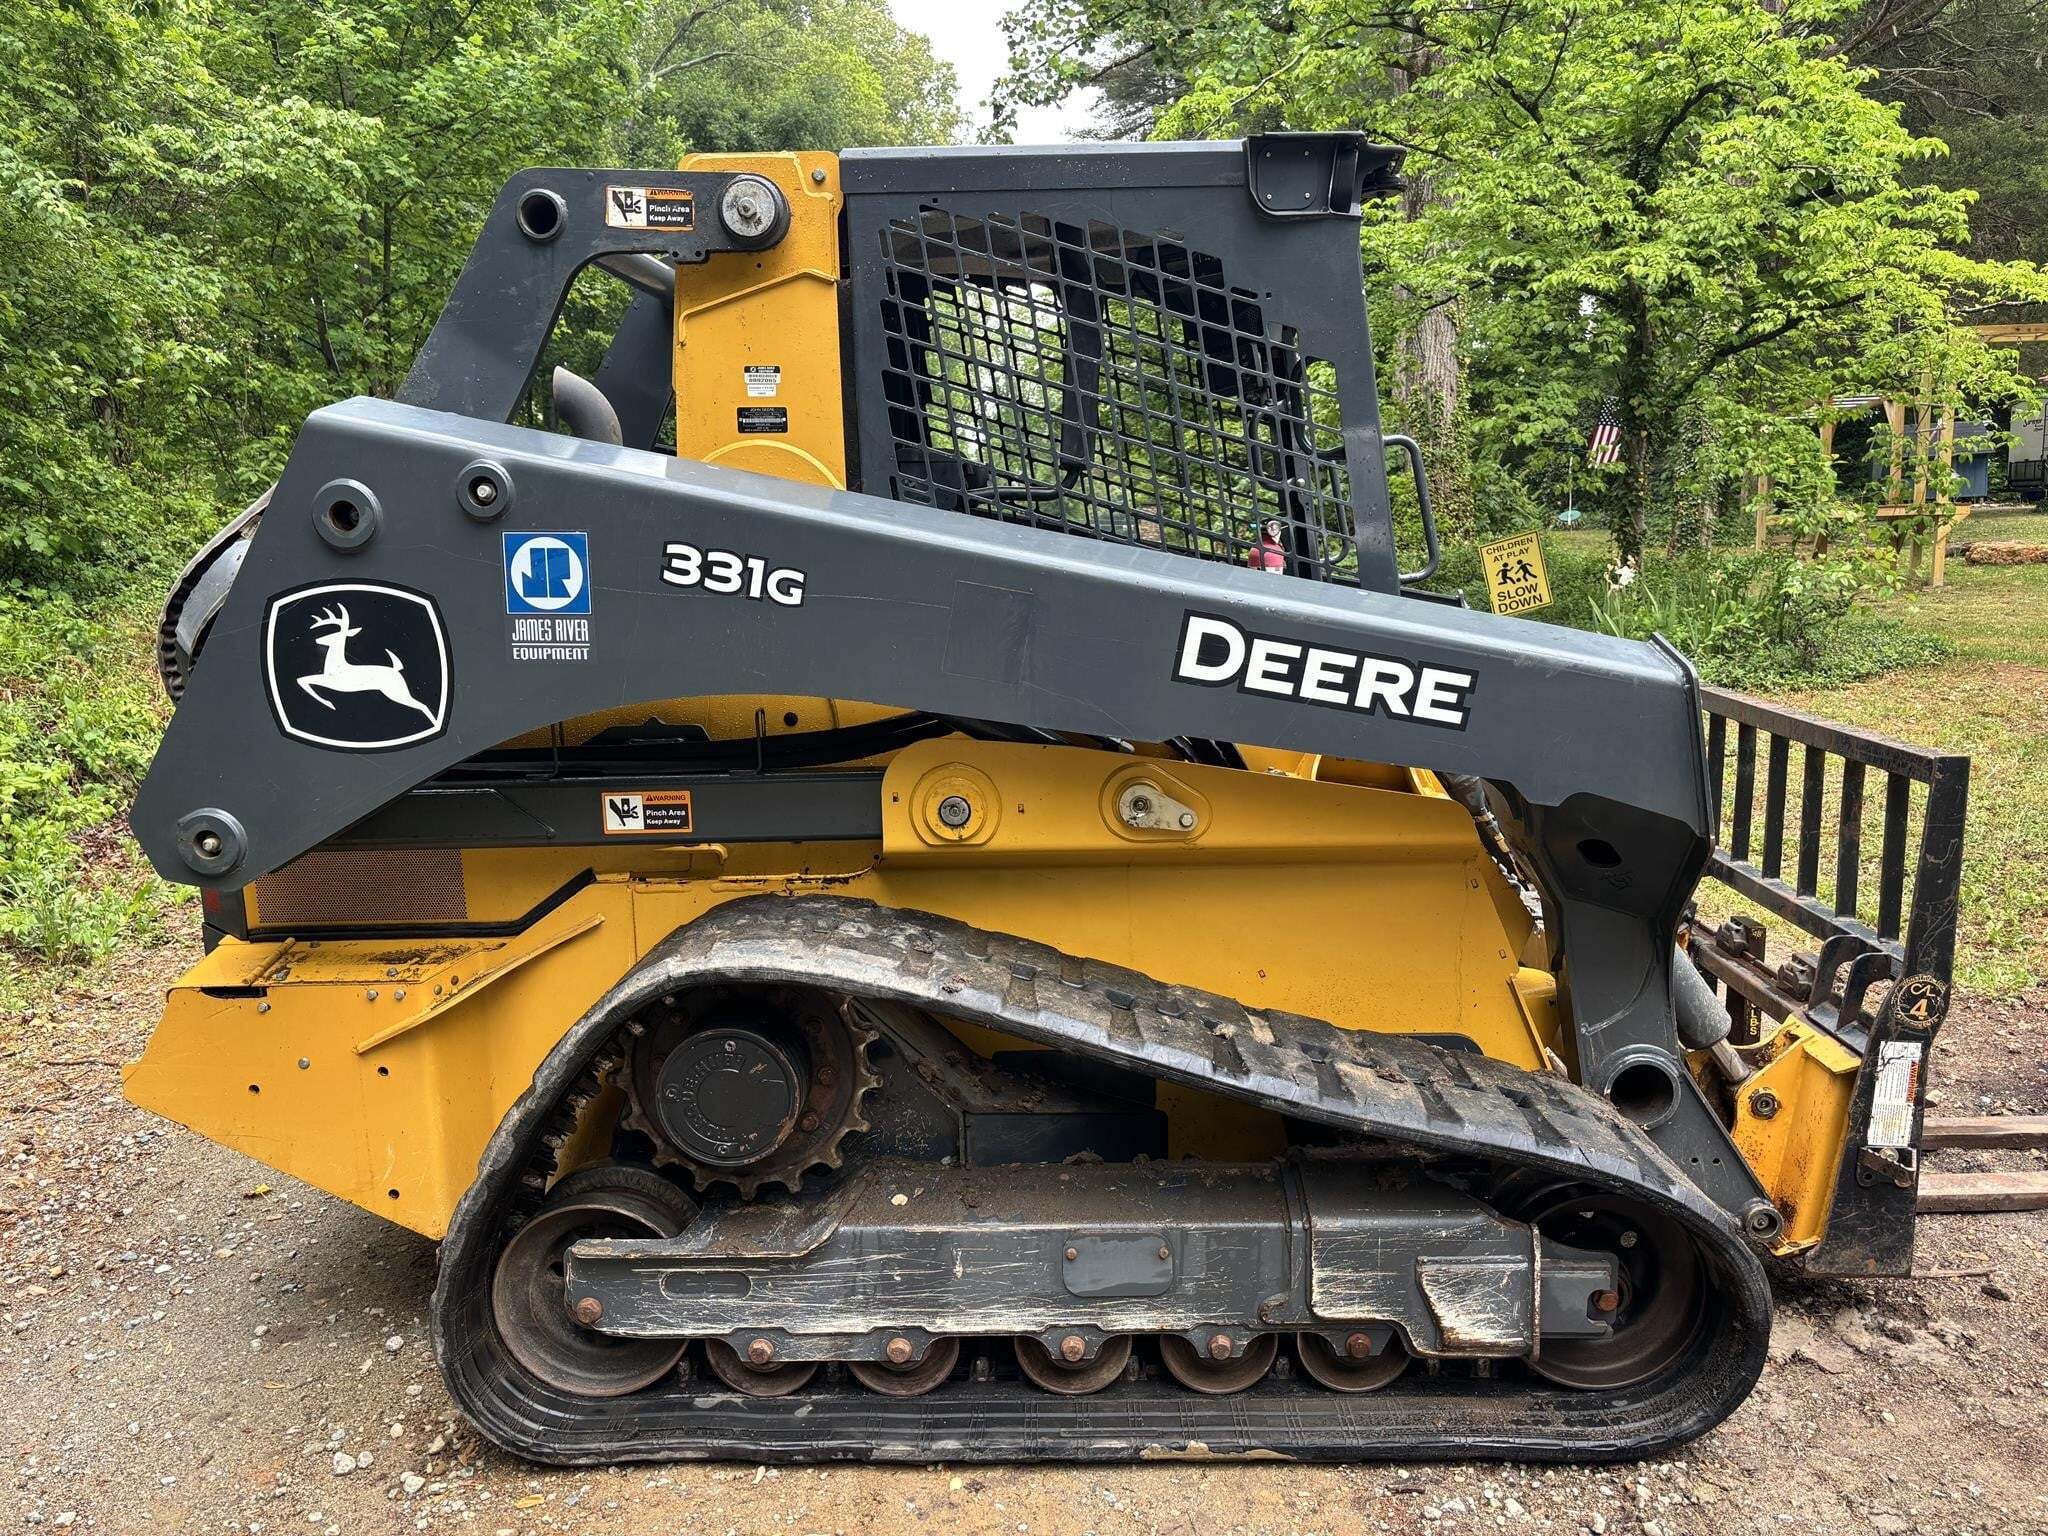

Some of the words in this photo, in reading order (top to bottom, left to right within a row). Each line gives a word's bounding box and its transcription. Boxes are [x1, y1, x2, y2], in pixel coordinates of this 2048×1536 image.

[649, 204, 671, 213] Pinch
[672, 205, 690, 213] Area
[649, 214, 666, 222] Keep
[667, 215, 685, 223] Away
[1486, 536, 1534, 555] CHILDREN
[1493, 554, 1504, 563] AT
[1506, 547, 1530, 559] PLAY
[661, 542, 806, 606] 331G
[1497, 582, 1539, 602] SLOW
[1498, 593, 1543, 613] DOWN
[511, 618, 552, 643] JAMES
[556, 618, 590, 643] RIVER
[512, 647, 590, 661] EQUIPMENT
[1178, 615, 1473, 725] DEERE
[1909, 998, 1929, 1020] 4
